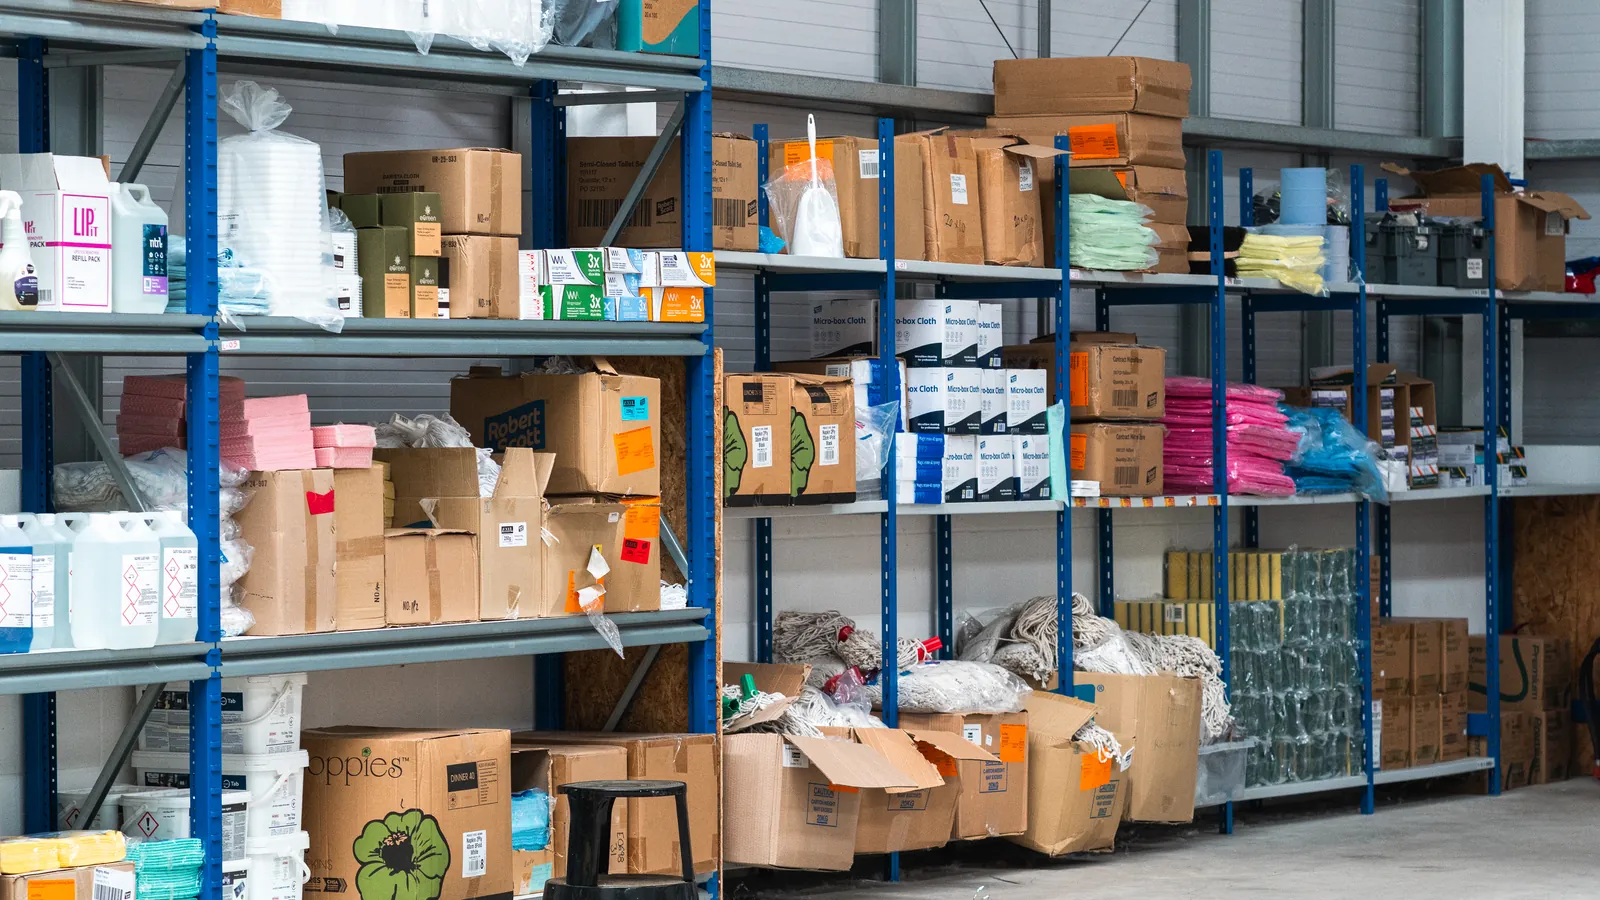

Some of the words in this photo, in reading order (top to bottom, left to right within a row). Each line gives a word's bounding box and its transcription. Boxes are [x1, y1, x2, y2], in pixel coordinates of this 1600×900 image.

[588, 254, 600, 268] 3x
[700, 254, 712, 268] 3x
[590, 294, 600, 308] 3x
[604, 302, 611, 311] x
[690, 295, 702, 310] 3x
[995, 386, 1004, 394] Cloth
[488, 408, 540, 440] Robert
[450, 773, 468, 782] DINNER
[469, 772, 475, 780] 40
[814, 787, 834, 797] CAUTION
[311, 860, 333, 870] KINS
